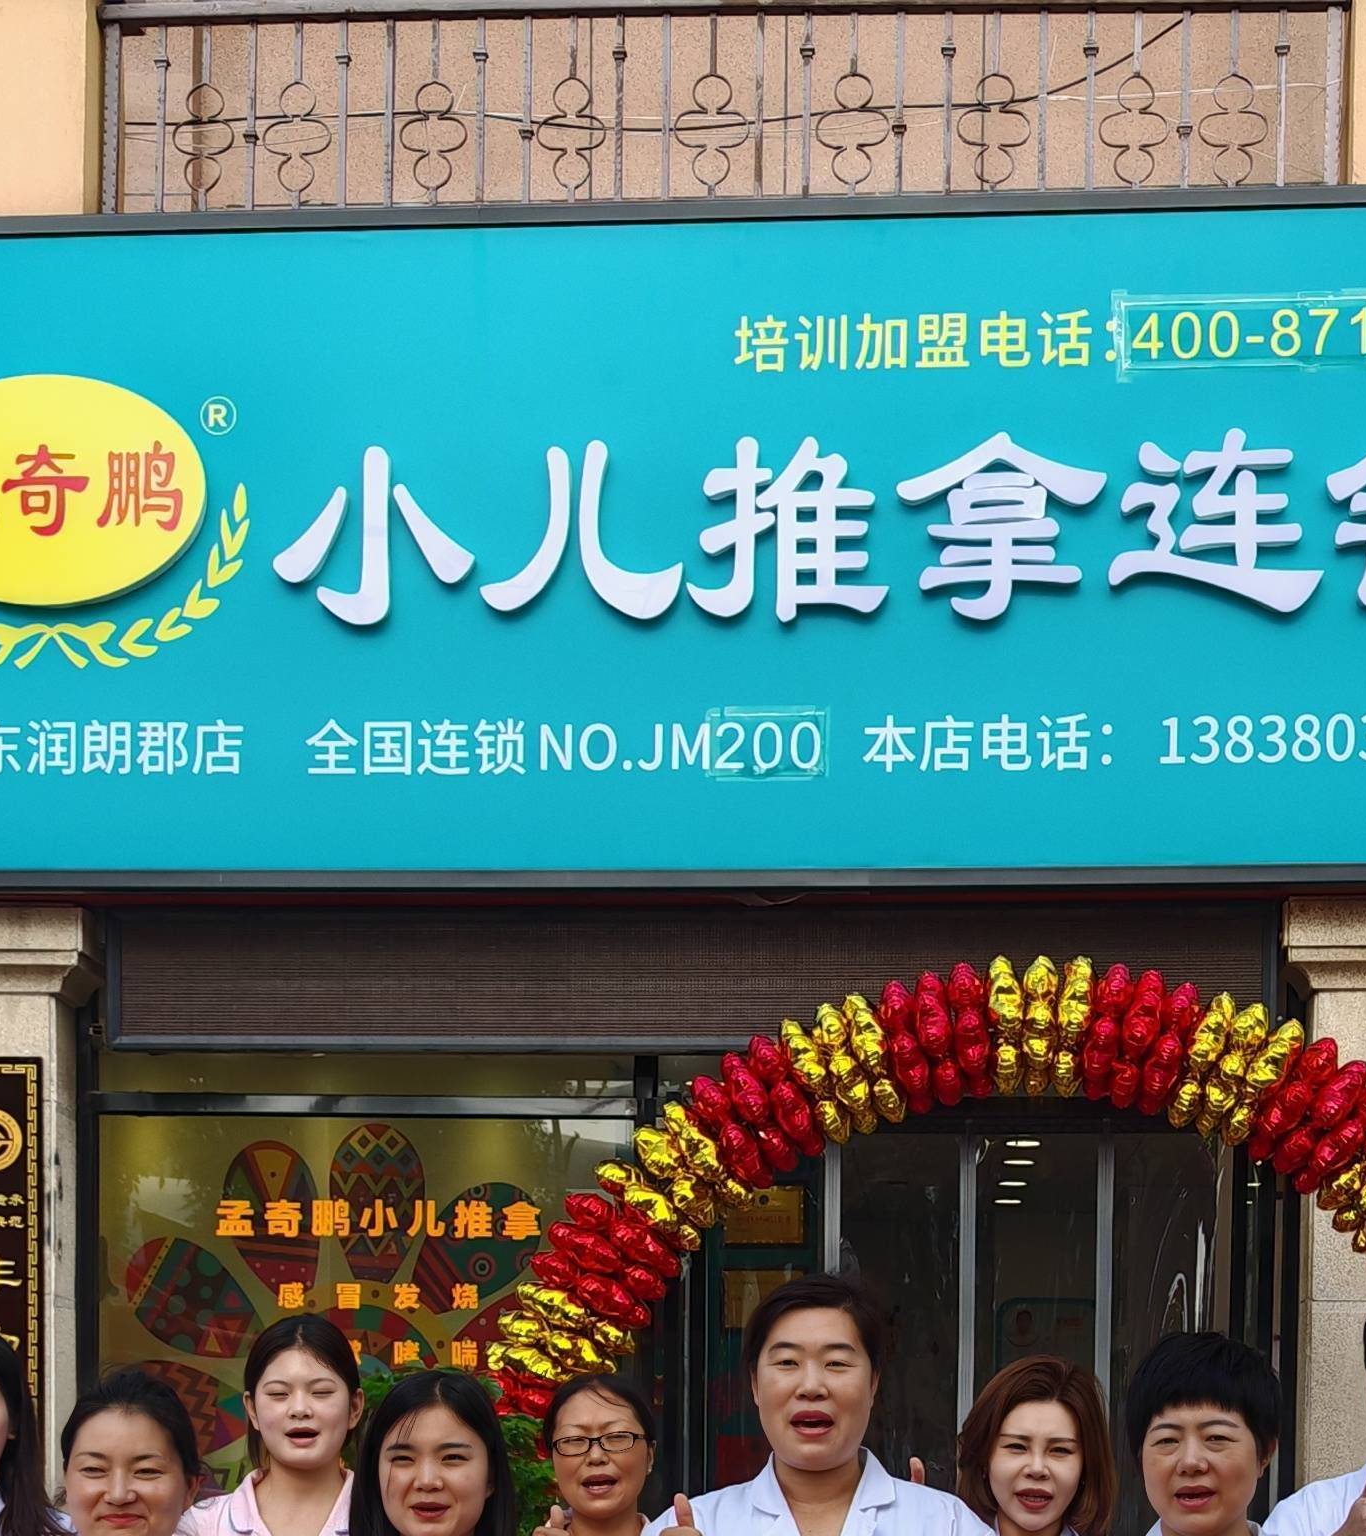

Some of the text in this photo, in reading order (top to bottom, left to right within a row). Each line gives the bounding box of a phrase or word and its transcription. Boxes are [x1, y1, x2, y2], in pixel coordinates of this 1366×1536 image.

[215, 1198, 542, 1240] 孟奇鹏小儿推拿
